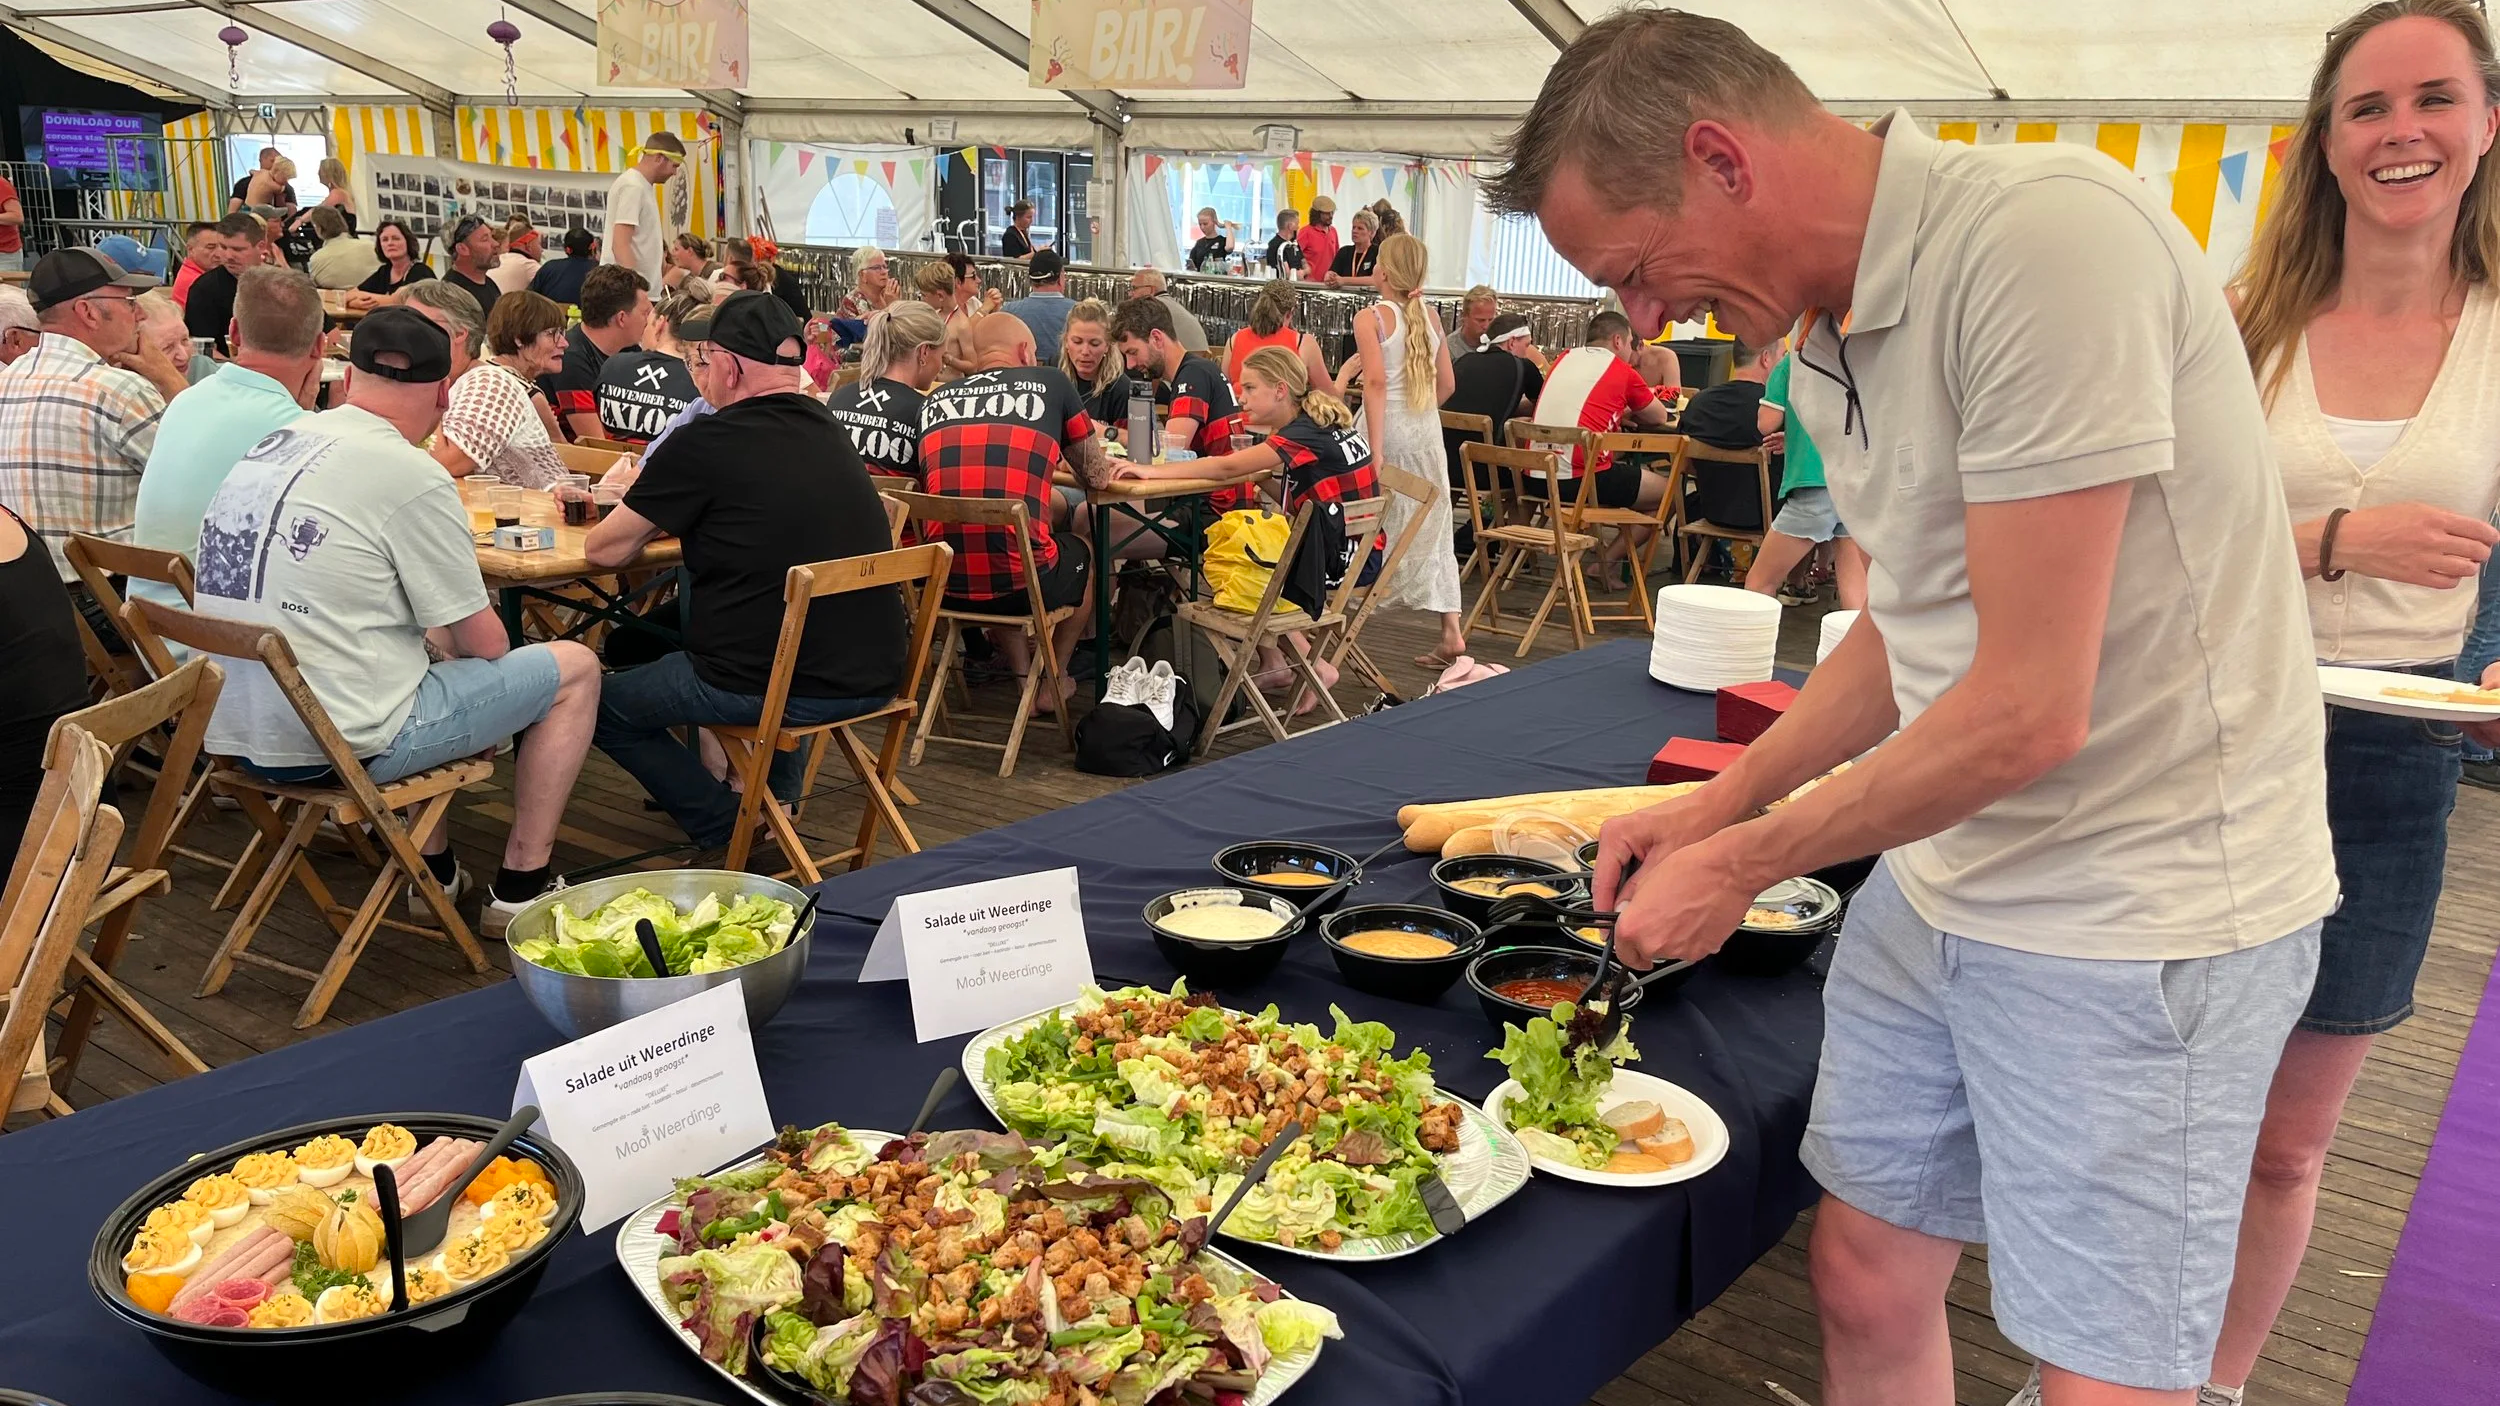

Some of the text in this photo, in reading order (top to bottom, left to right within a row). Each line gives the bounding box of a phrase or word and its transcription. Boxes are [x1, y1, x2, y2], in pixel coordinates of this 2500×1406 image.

[637, 20, 717, 84] BAR!
[1089, 6, 1206, 84] BAR!
[45, 115, 140, 129] DOWNLOAD OUR
[48, 144, 95, 153] Eventcode
[606, 384, 666, 407] NOVEMBER
[930, 382, 1008, 403] NOVEMBER
[1013, 381, 1048, 394] 2019
[600, 396, 679, 436] EXLO
[920, 393, 1046, 433] EXLOO
[1331, 430, 1341, 441] 3
[281, 601, 309, 614] BOSS
[924, 899, 1052, 929] Salade uit Weerdinge
[956, 962, 1053, 991] Mooi Weerdinge
[565, 1025, 716, 1094] Salade uit Weerdinge
[615, 1101, 722, 1160] Mooi Weerdinge
